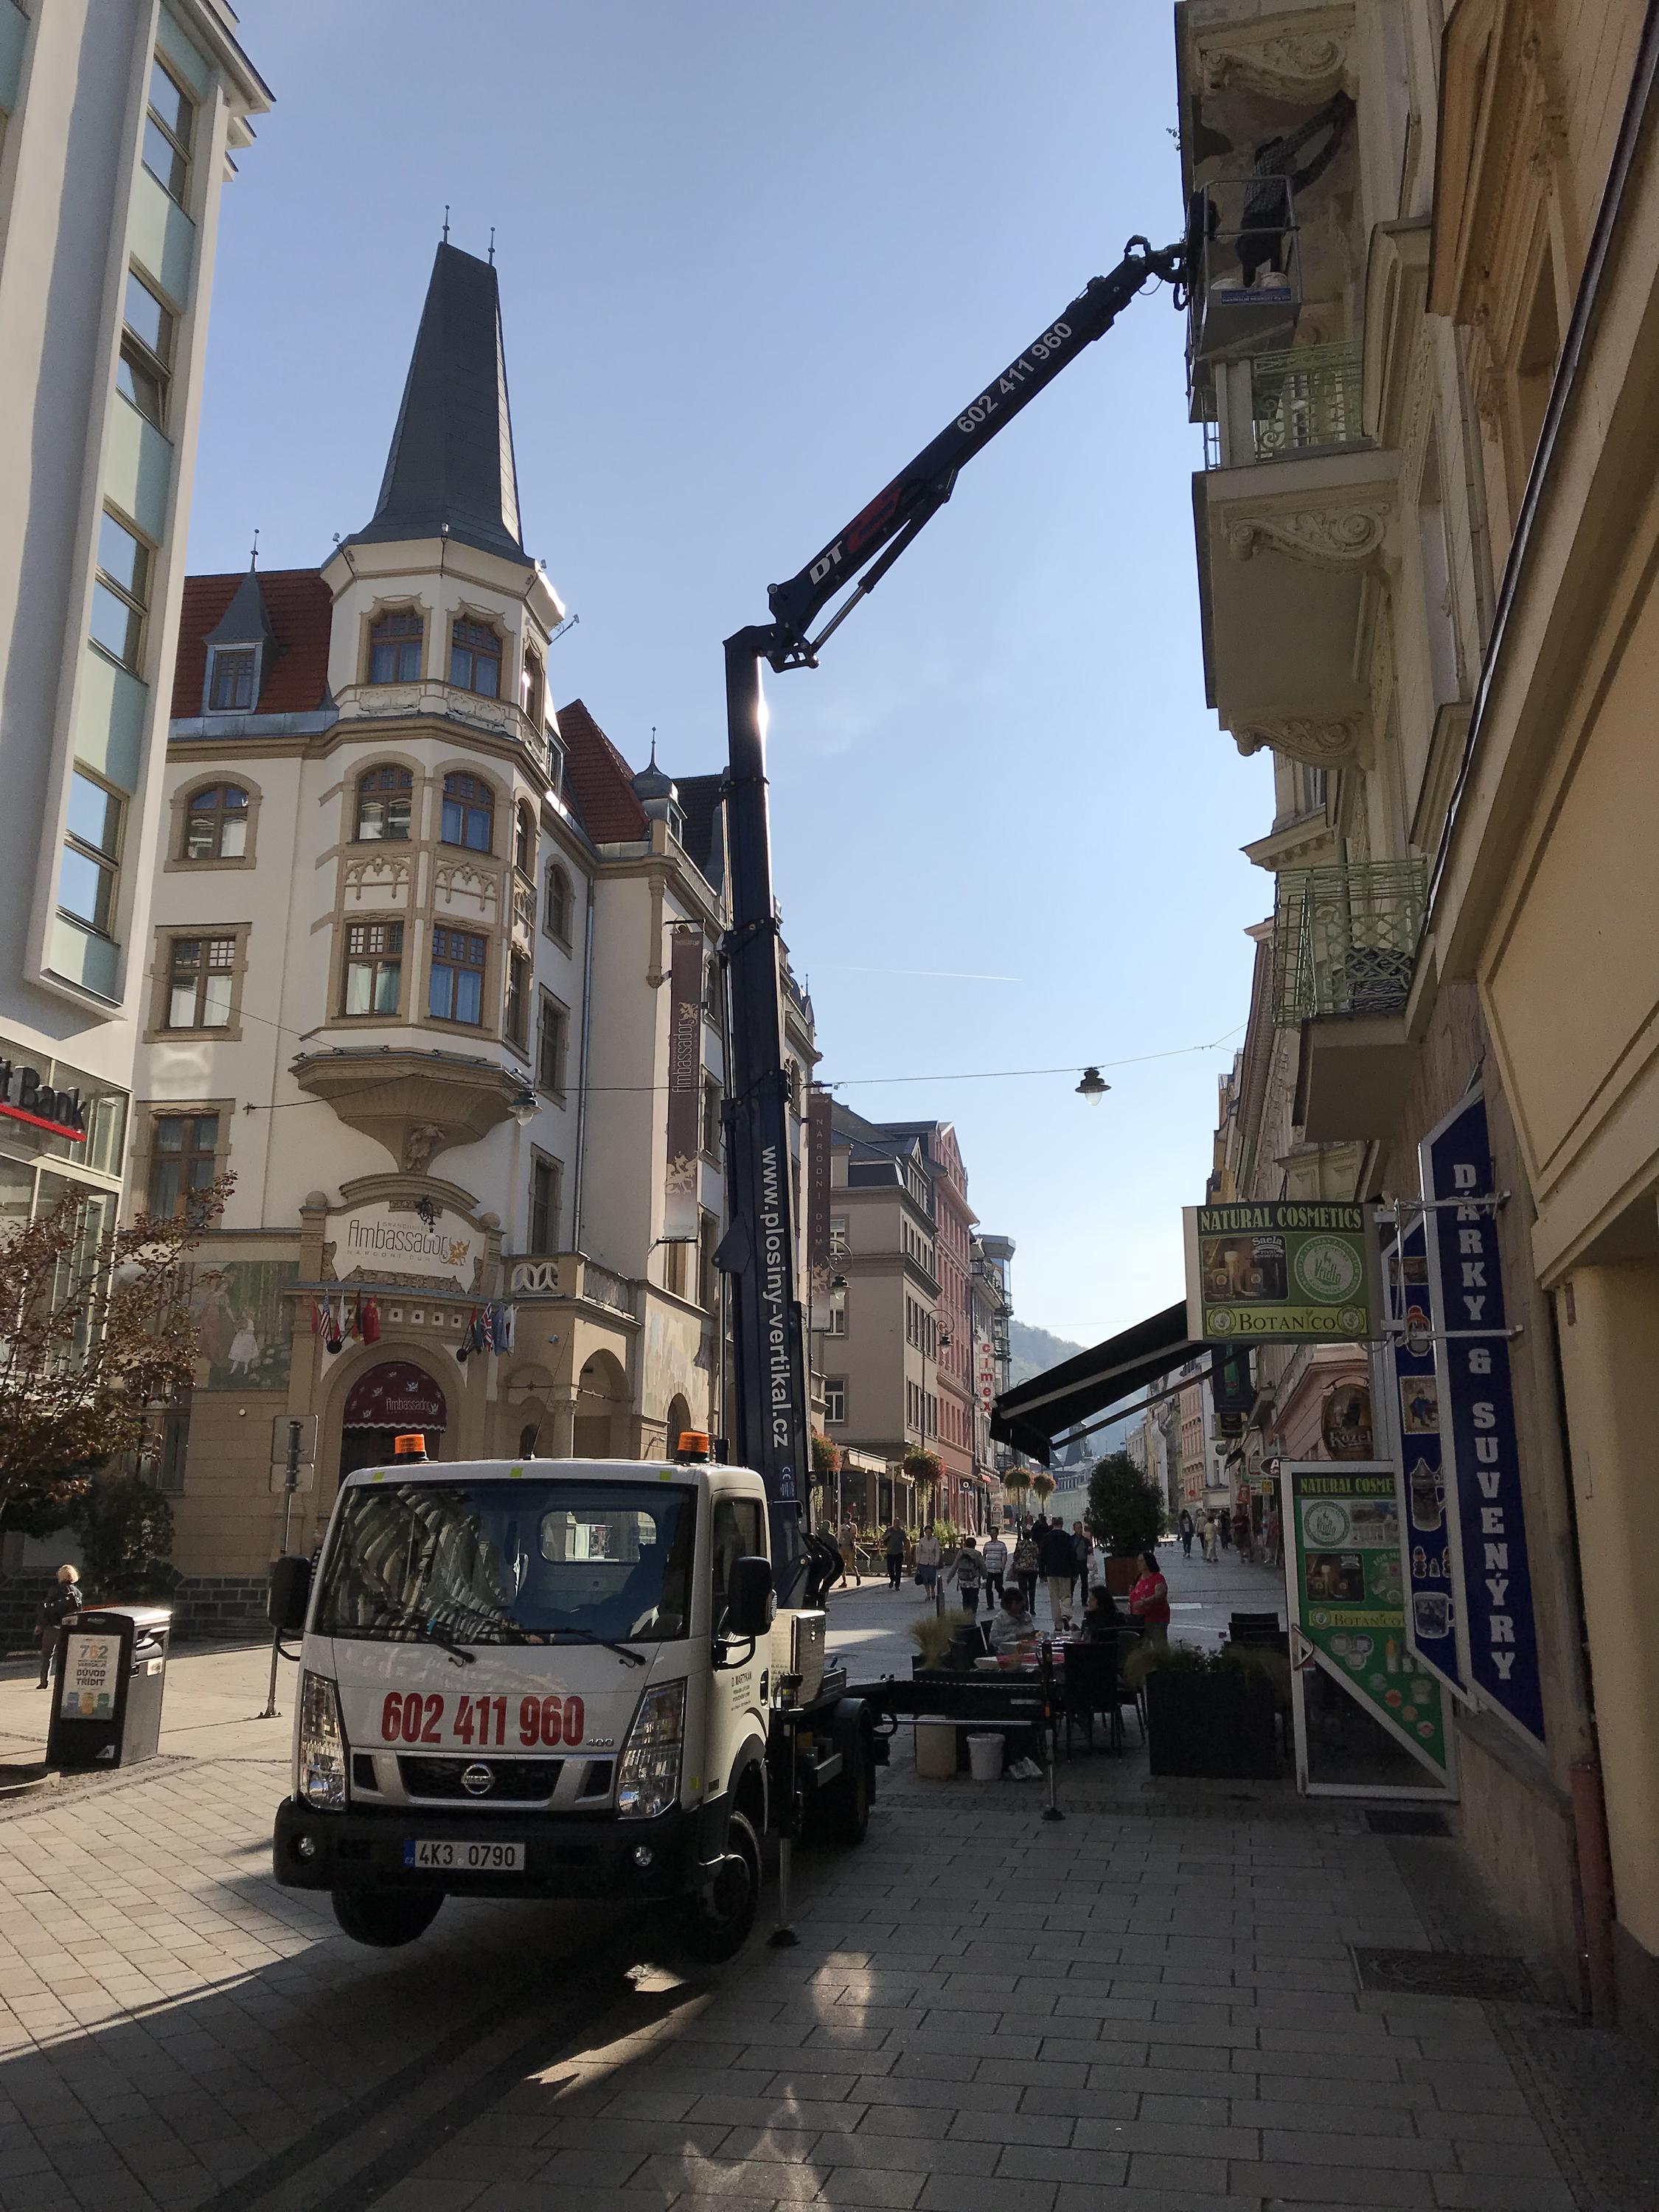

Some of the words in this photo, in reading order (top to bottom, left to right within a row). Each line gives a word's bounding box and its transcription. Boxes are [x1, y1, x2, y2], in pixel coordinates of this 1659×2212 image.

[957, 394, 998, 432] 602
[998, 359, 1034, 395] 411
[1032, 322, 1072, 360] 960
[809, 541, 843, 585] DT
[672, 1020, 695, 1093] Ambassador
[11, 1065, 87, 1130] Bank
[1200, 1207, 1274, 1231] NATURAL
[1277, 1207, 1362, 1229] COSMETICS
[348, 1220, 448, 1261] Ambassador
[760, 1145, 789, 1448] www.plosiny-vertikal.cz
[981, 1343, 993, 1413] cimex
[1468, 1349, 1492, 1374] &
[386, 1397, 432, 1411] Ambassador
[1329, 1430, 1372, 1448] Kozel
[1300, 1477, 1353, 1493] NATURAL
[1472, 1401, 1515, 1680] SUVENÝRY
[381, 1691, 444, 1743] 602
[453, 1695, 507, 1745] 411
[519, 1695, 585, 1746] 960
[585, 1737, 614, 1747] 400
[419, 1843, 453, 1865] 4K3
[468, 1846, 515, 1867] 0790
